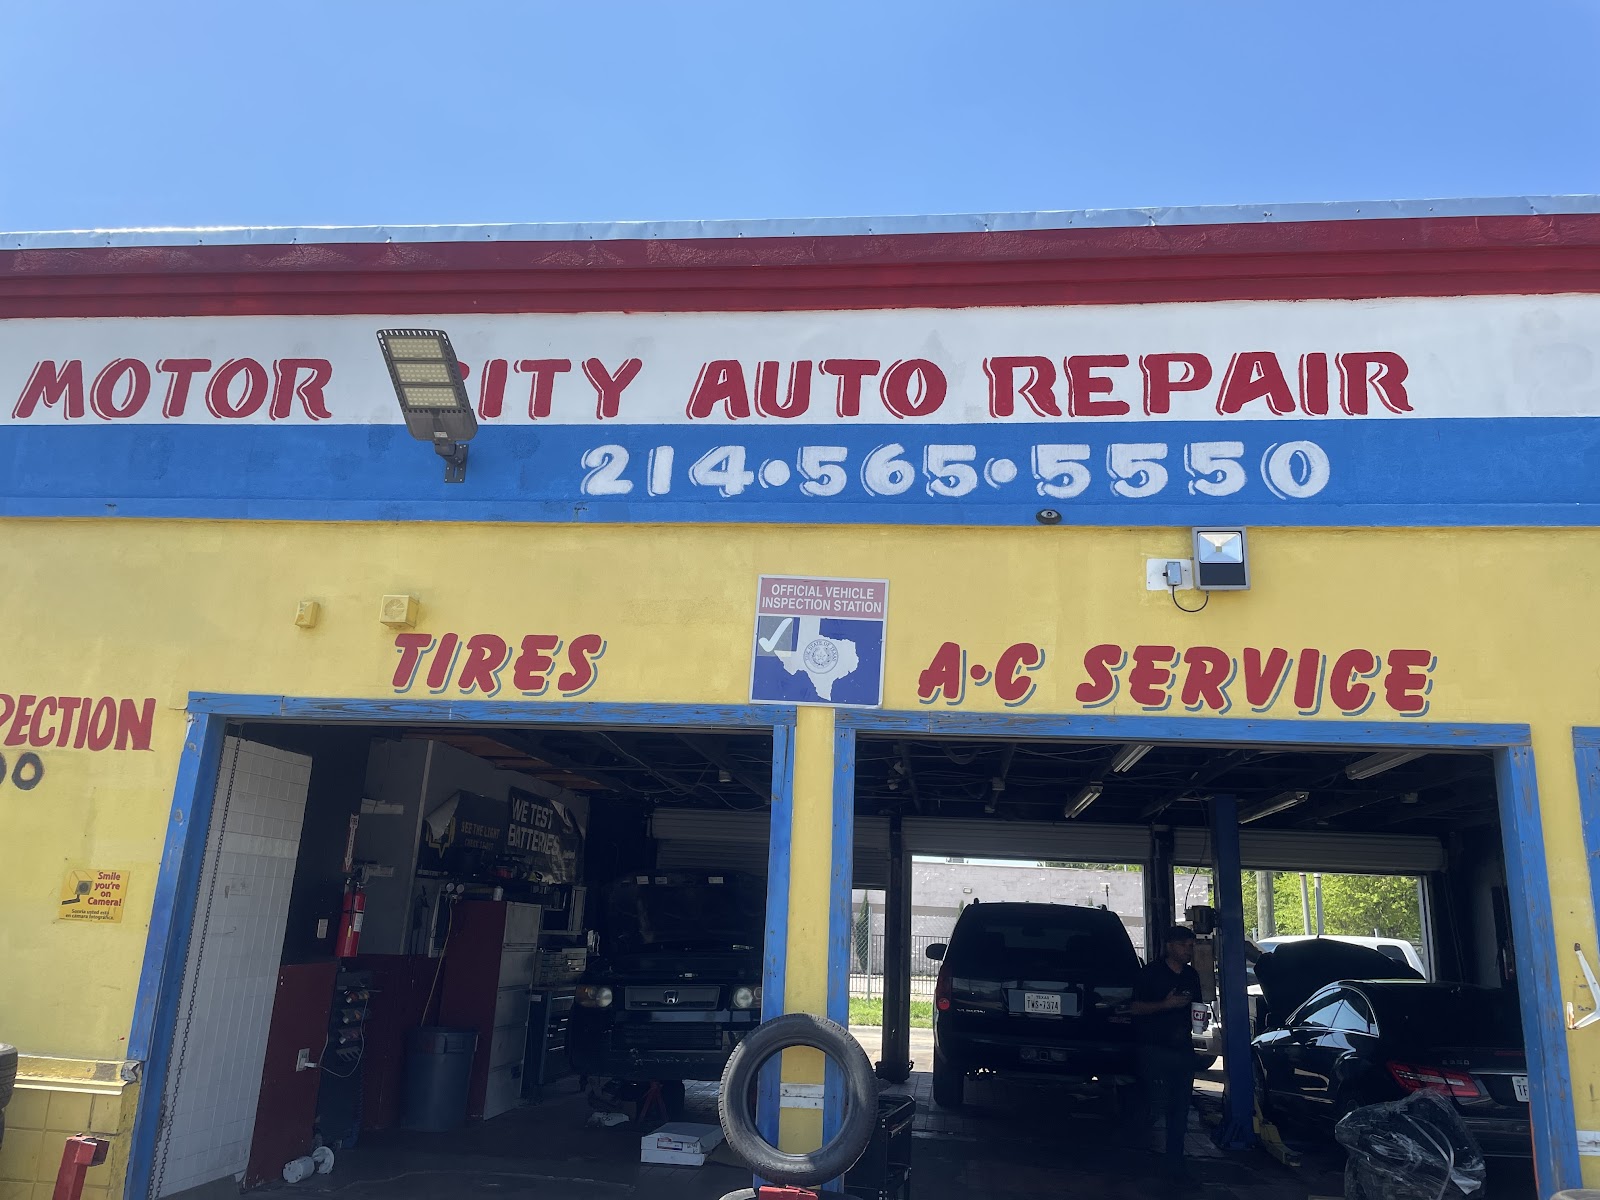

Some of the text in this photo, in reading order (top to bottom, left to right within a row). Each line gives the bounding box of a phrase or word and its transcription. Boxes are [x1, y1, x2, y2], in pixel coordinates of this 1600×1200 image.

[11, 351, 1415, 421] MOTOR ITY AUTO REPAIR
[771, 584, 875, 600] OFFICIAL VEHICLE
[762, 597, 882, 613] INSPECTION STATION
[392, 633, 608, 698] TIRES
[1075, 644, 1437, 715] SERVICE
[512, 797, 553, 829] WE TEST
[507, 824, 560, 856] BATTERIES
[94, 881, 121, 891] you're
[98, 871, 121, 880] Smile
[87, 897, 122, 907] Camera!
